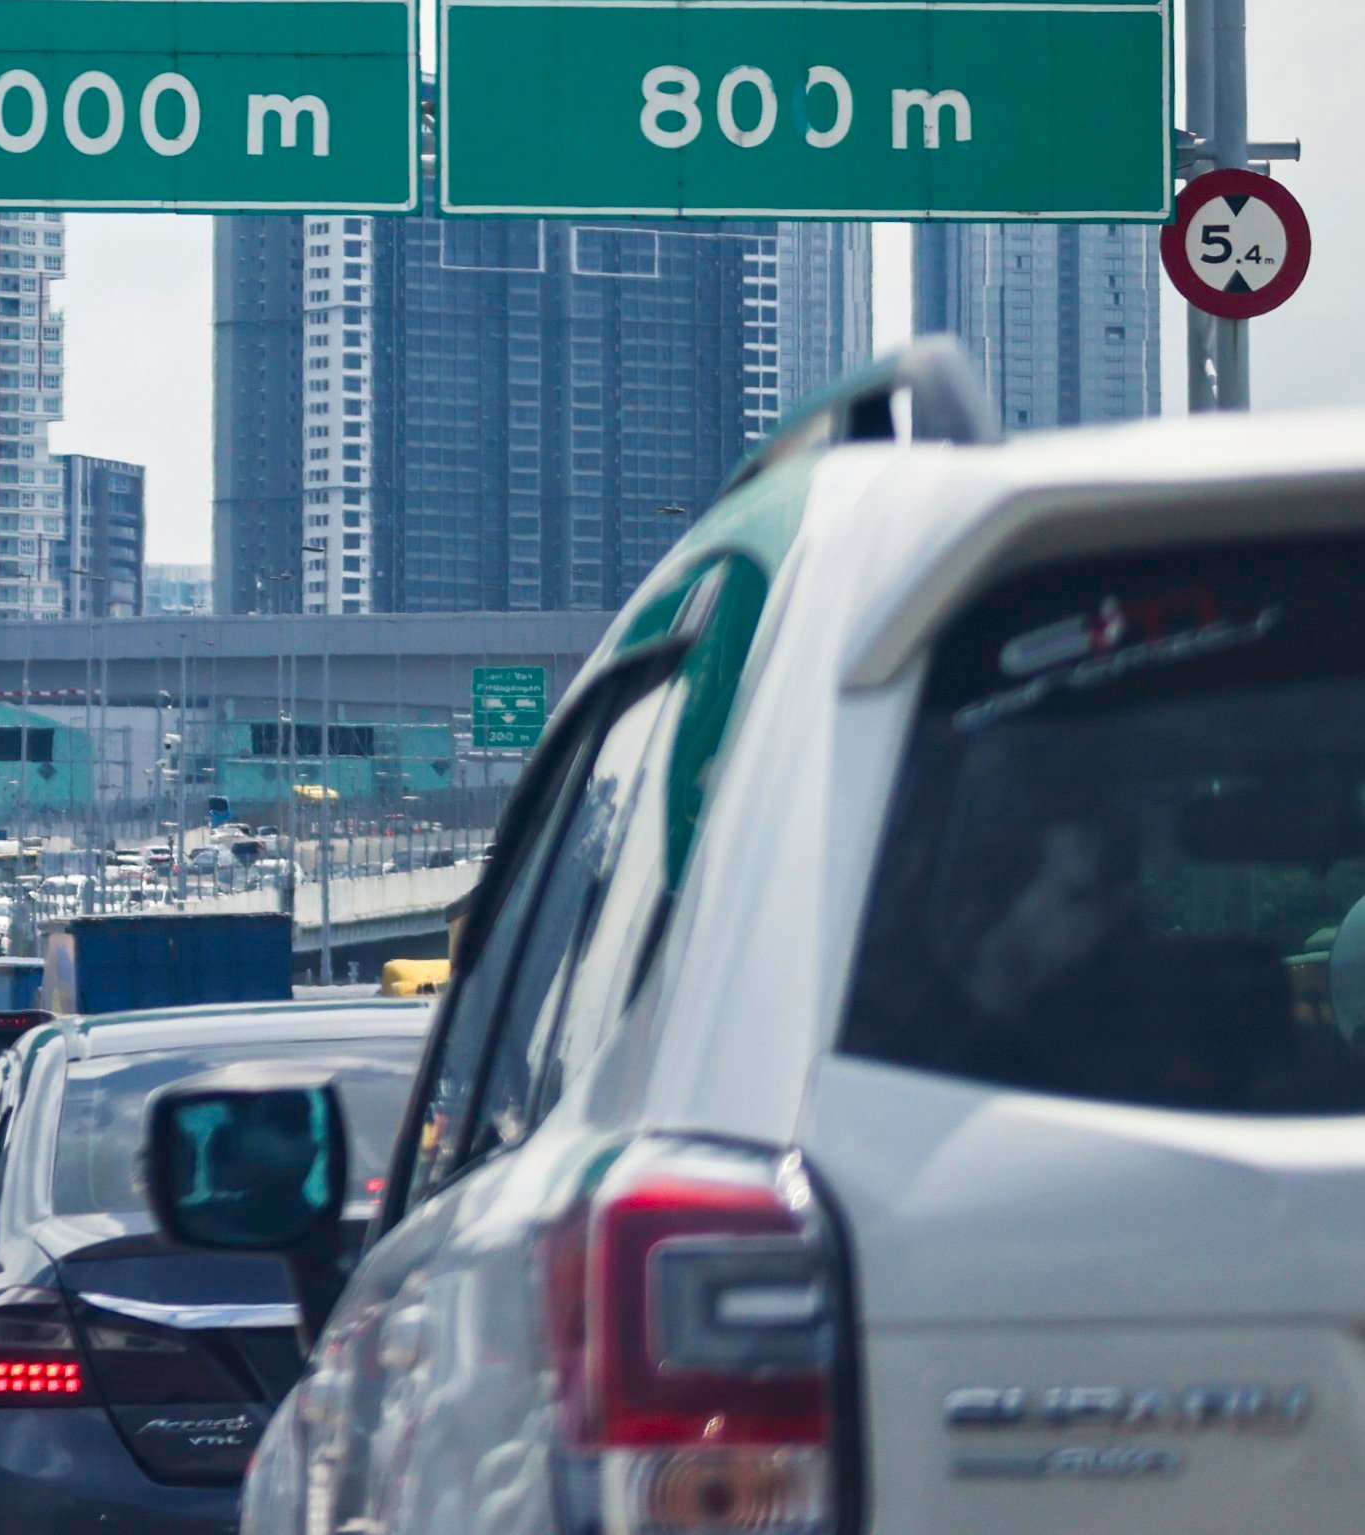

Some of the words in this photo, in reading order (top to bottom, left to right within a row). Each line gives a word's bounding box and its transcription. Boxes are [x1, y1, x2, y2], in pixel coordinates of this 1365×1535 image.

[247, 93, 330, 157] m
[639, 64, 854, 149] 800
[892, 88, 972, 150] m
